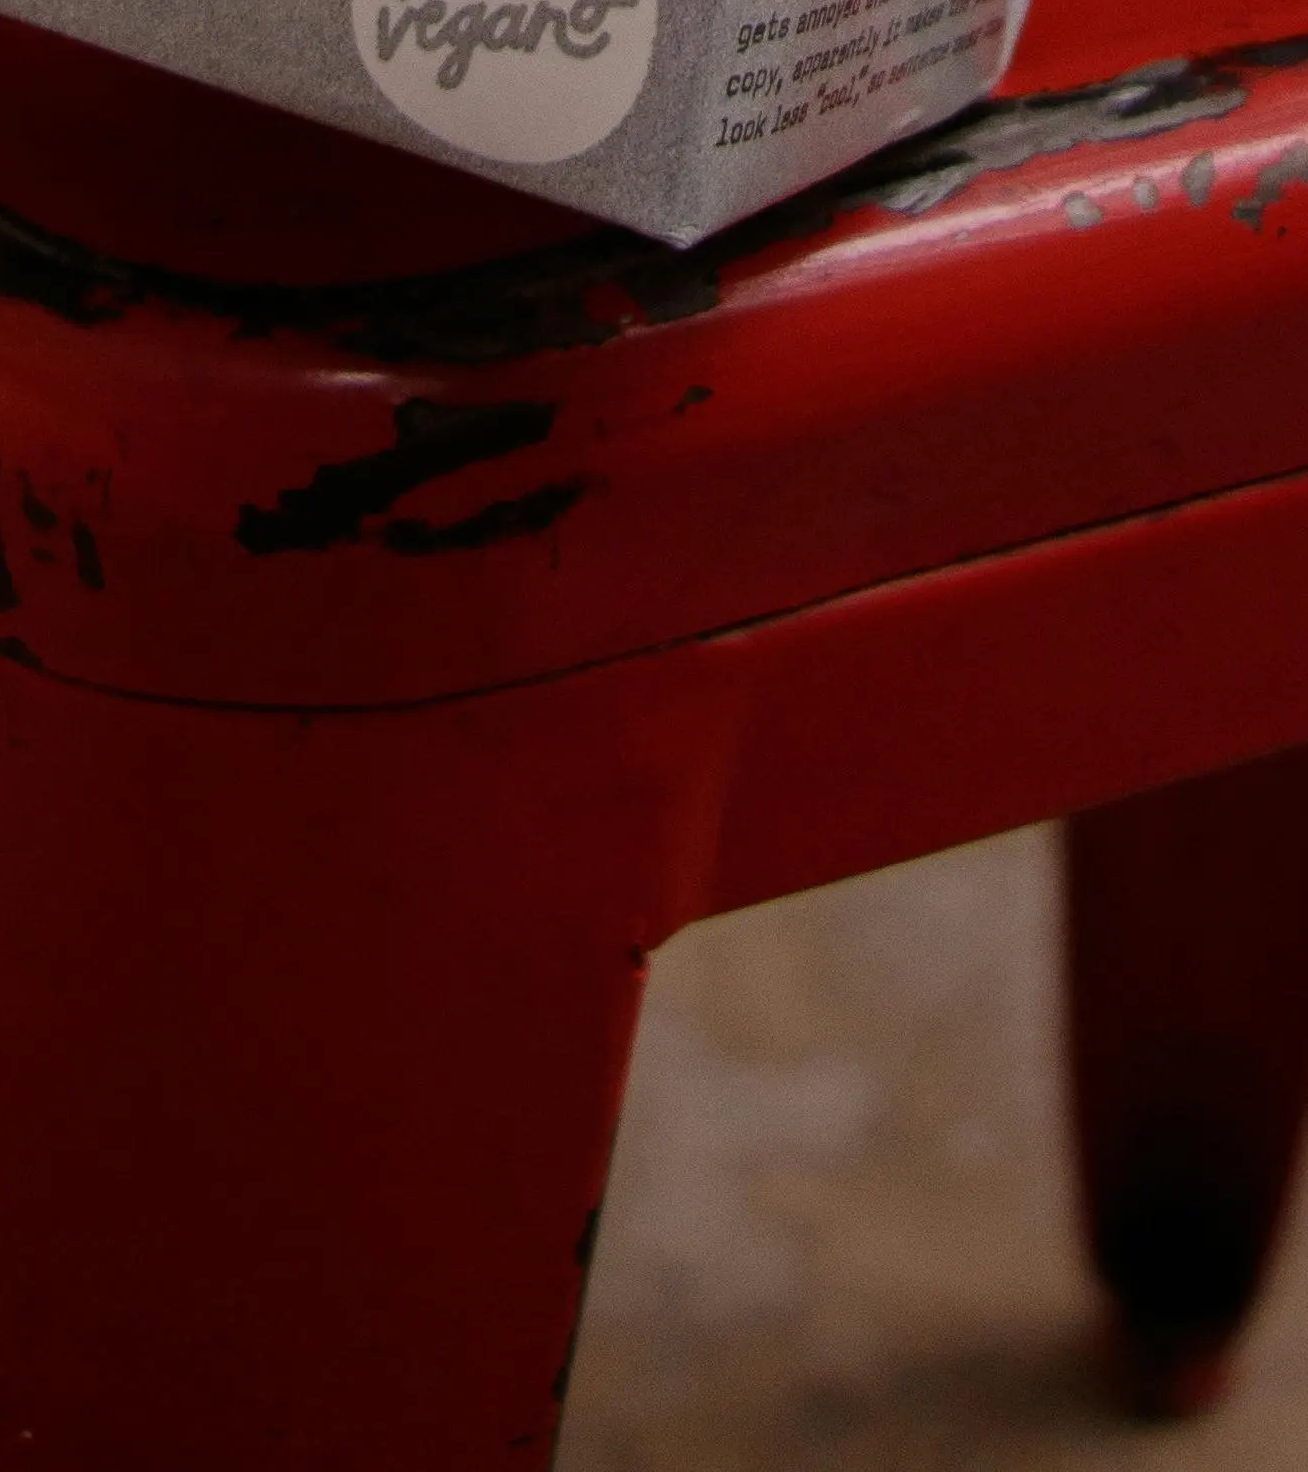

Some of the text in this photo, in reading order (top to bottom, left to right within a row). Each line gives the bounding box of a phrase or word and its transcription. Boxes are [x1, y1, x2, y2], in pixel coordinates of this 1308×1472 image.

[736, 11, 790, 54] gets
[725, 65, 784, 98] copy,
[791, 26, 879, 83] apparently
[714, 114, 767, 148] look
[770, 102, 809, 134] less
